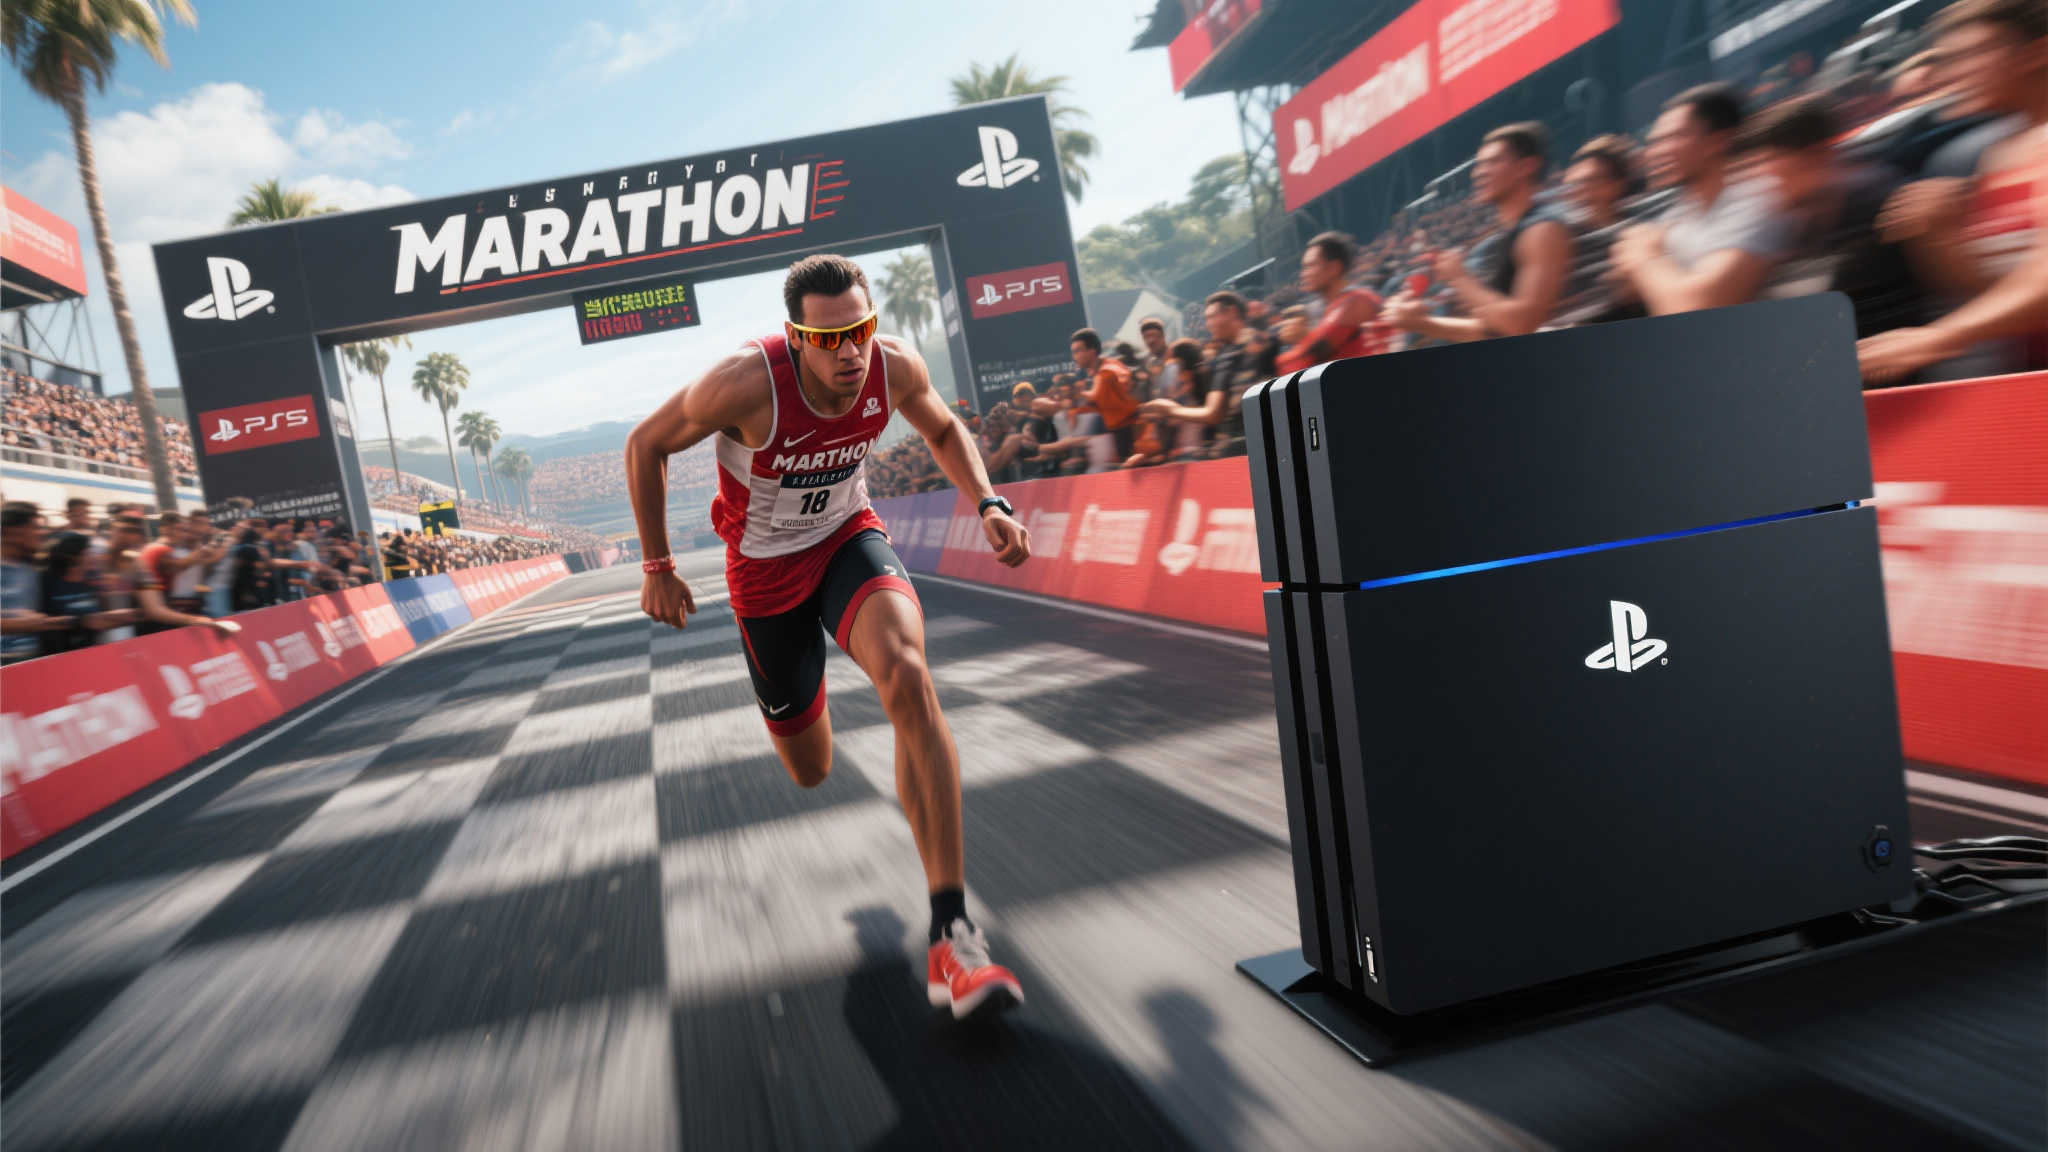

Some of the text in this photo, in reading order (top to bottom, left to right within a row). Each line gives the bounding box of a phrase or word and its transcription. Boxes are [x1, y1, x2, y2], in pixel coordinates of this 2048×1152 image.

[390, 163, 810, 294] MARATHON
[1005, 275, 1063, 300] PS5
[243, 408, 309, 434] PS5
[800, 489, 830, 515] 18
